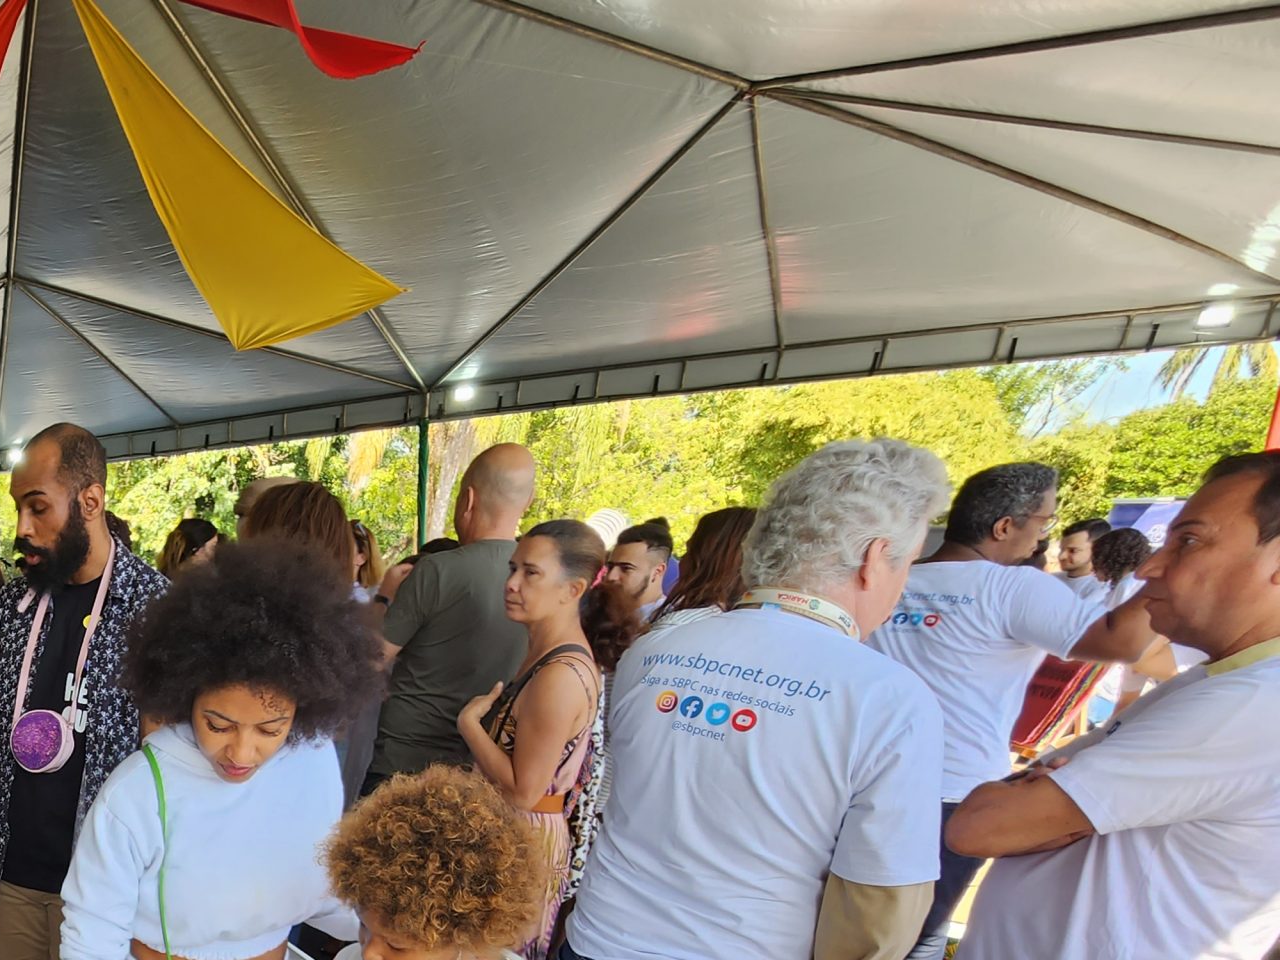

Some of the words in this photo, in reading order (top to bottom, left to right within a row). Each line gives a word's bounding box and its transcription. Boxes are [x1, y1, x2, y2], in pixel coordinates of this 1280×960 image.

[642, 652, 832, 703] www.sbpcnet.org.br
[669, 676, 700, 691] SBPC
[700, 684, 720, 697] nas
[721, 687, 754, 705] redes
[754, 697, 797, 717] sociais
[671, 720, 726, 742] @sbpcnet
